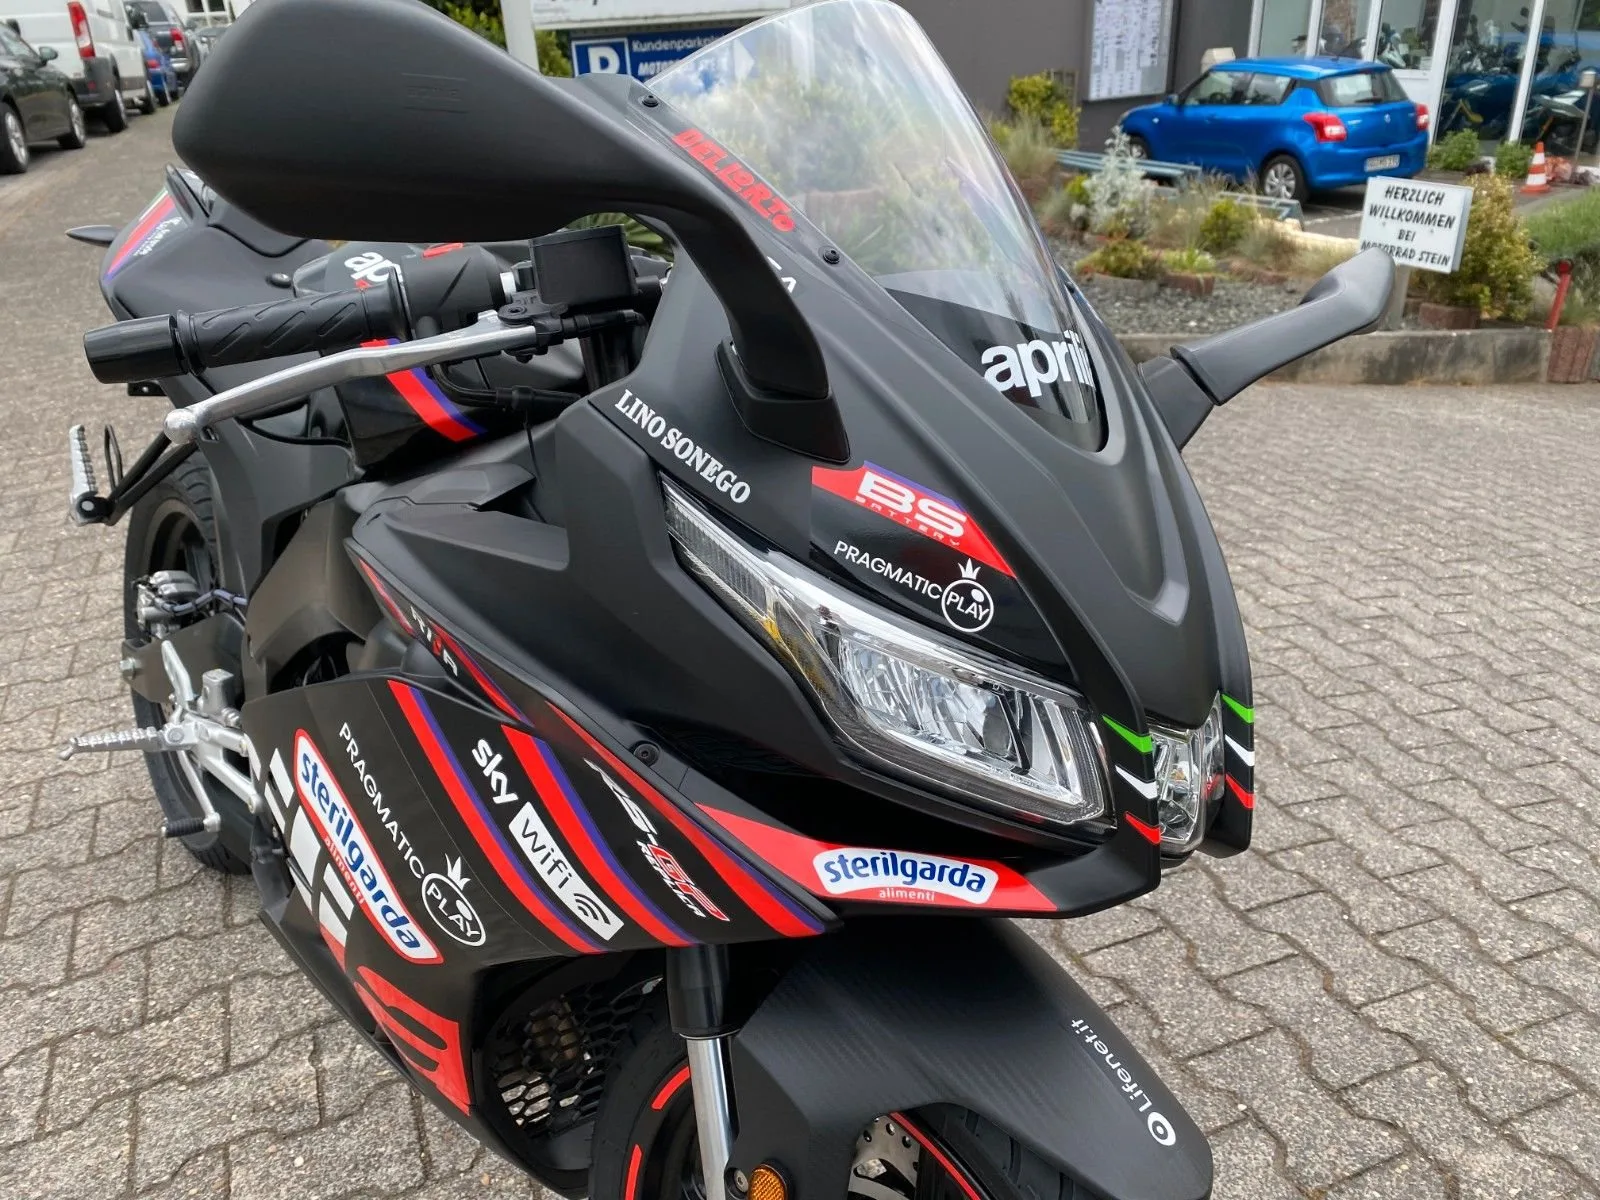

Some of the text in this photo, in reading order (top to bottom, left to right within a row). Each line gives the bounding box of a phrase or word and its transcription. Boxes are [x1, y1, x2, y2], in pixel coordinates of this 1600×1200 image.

[1368, 203, 1456, 229] WILLKOMMEN
[1385, 184, 1445, 206] HERZLICH
[1398, 229, 1416, 242] BEI
[1418, 250, 1451, 266] STEIN
[614, 389, 751, 503] LINO SONEGO
[857, 471, 967, 538] BS
[834, 540, 990, 621] PRAGMATIC PLAY
[471, 739, 519, 804] sky
[301, 752, 421, 949] sterilgarda
[339, 722, 481, 937] PRAGMATIC PLAY
[323, 832, 366, 905] alimenti
[823, 851, 986, 893] sterilgarda
[879, 888, 935, 902] alimenti
[1071, 1019, 1153, 1112] Lifenet.it
